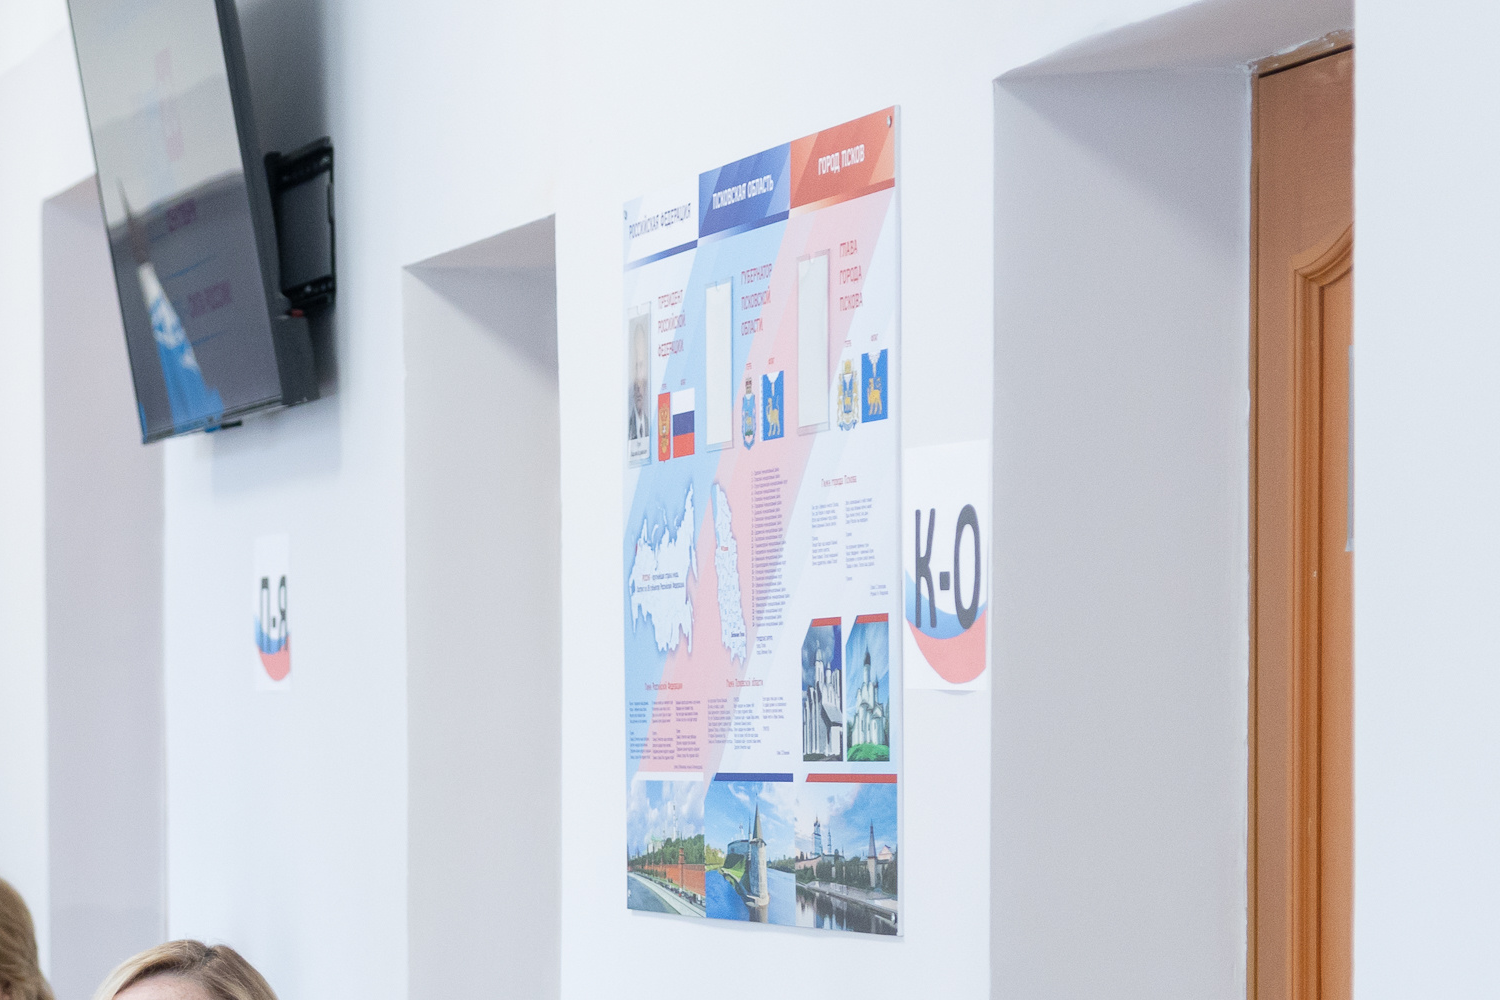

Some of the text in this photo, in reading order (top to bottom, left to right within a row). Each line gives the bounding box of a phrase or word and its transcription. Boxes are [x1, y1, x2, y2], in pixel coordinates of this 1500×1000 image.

[818, 144, 865, 175] ГОРОД ПСКОВ
[712, 174, 774, 210] ПСКОВСКАЯ ОБЛАСТЬ
[628, 203, 691, 240] РОССИЙСКАЯ ФЕДЕРАЦИЯ
[839, 239, 858, 258] ГЛАВА
[839, 265, 863, 285] ГОРОДА
[839, 292, 863, 312] ПСКОВА
[915, 503, 982, 630] К-О
